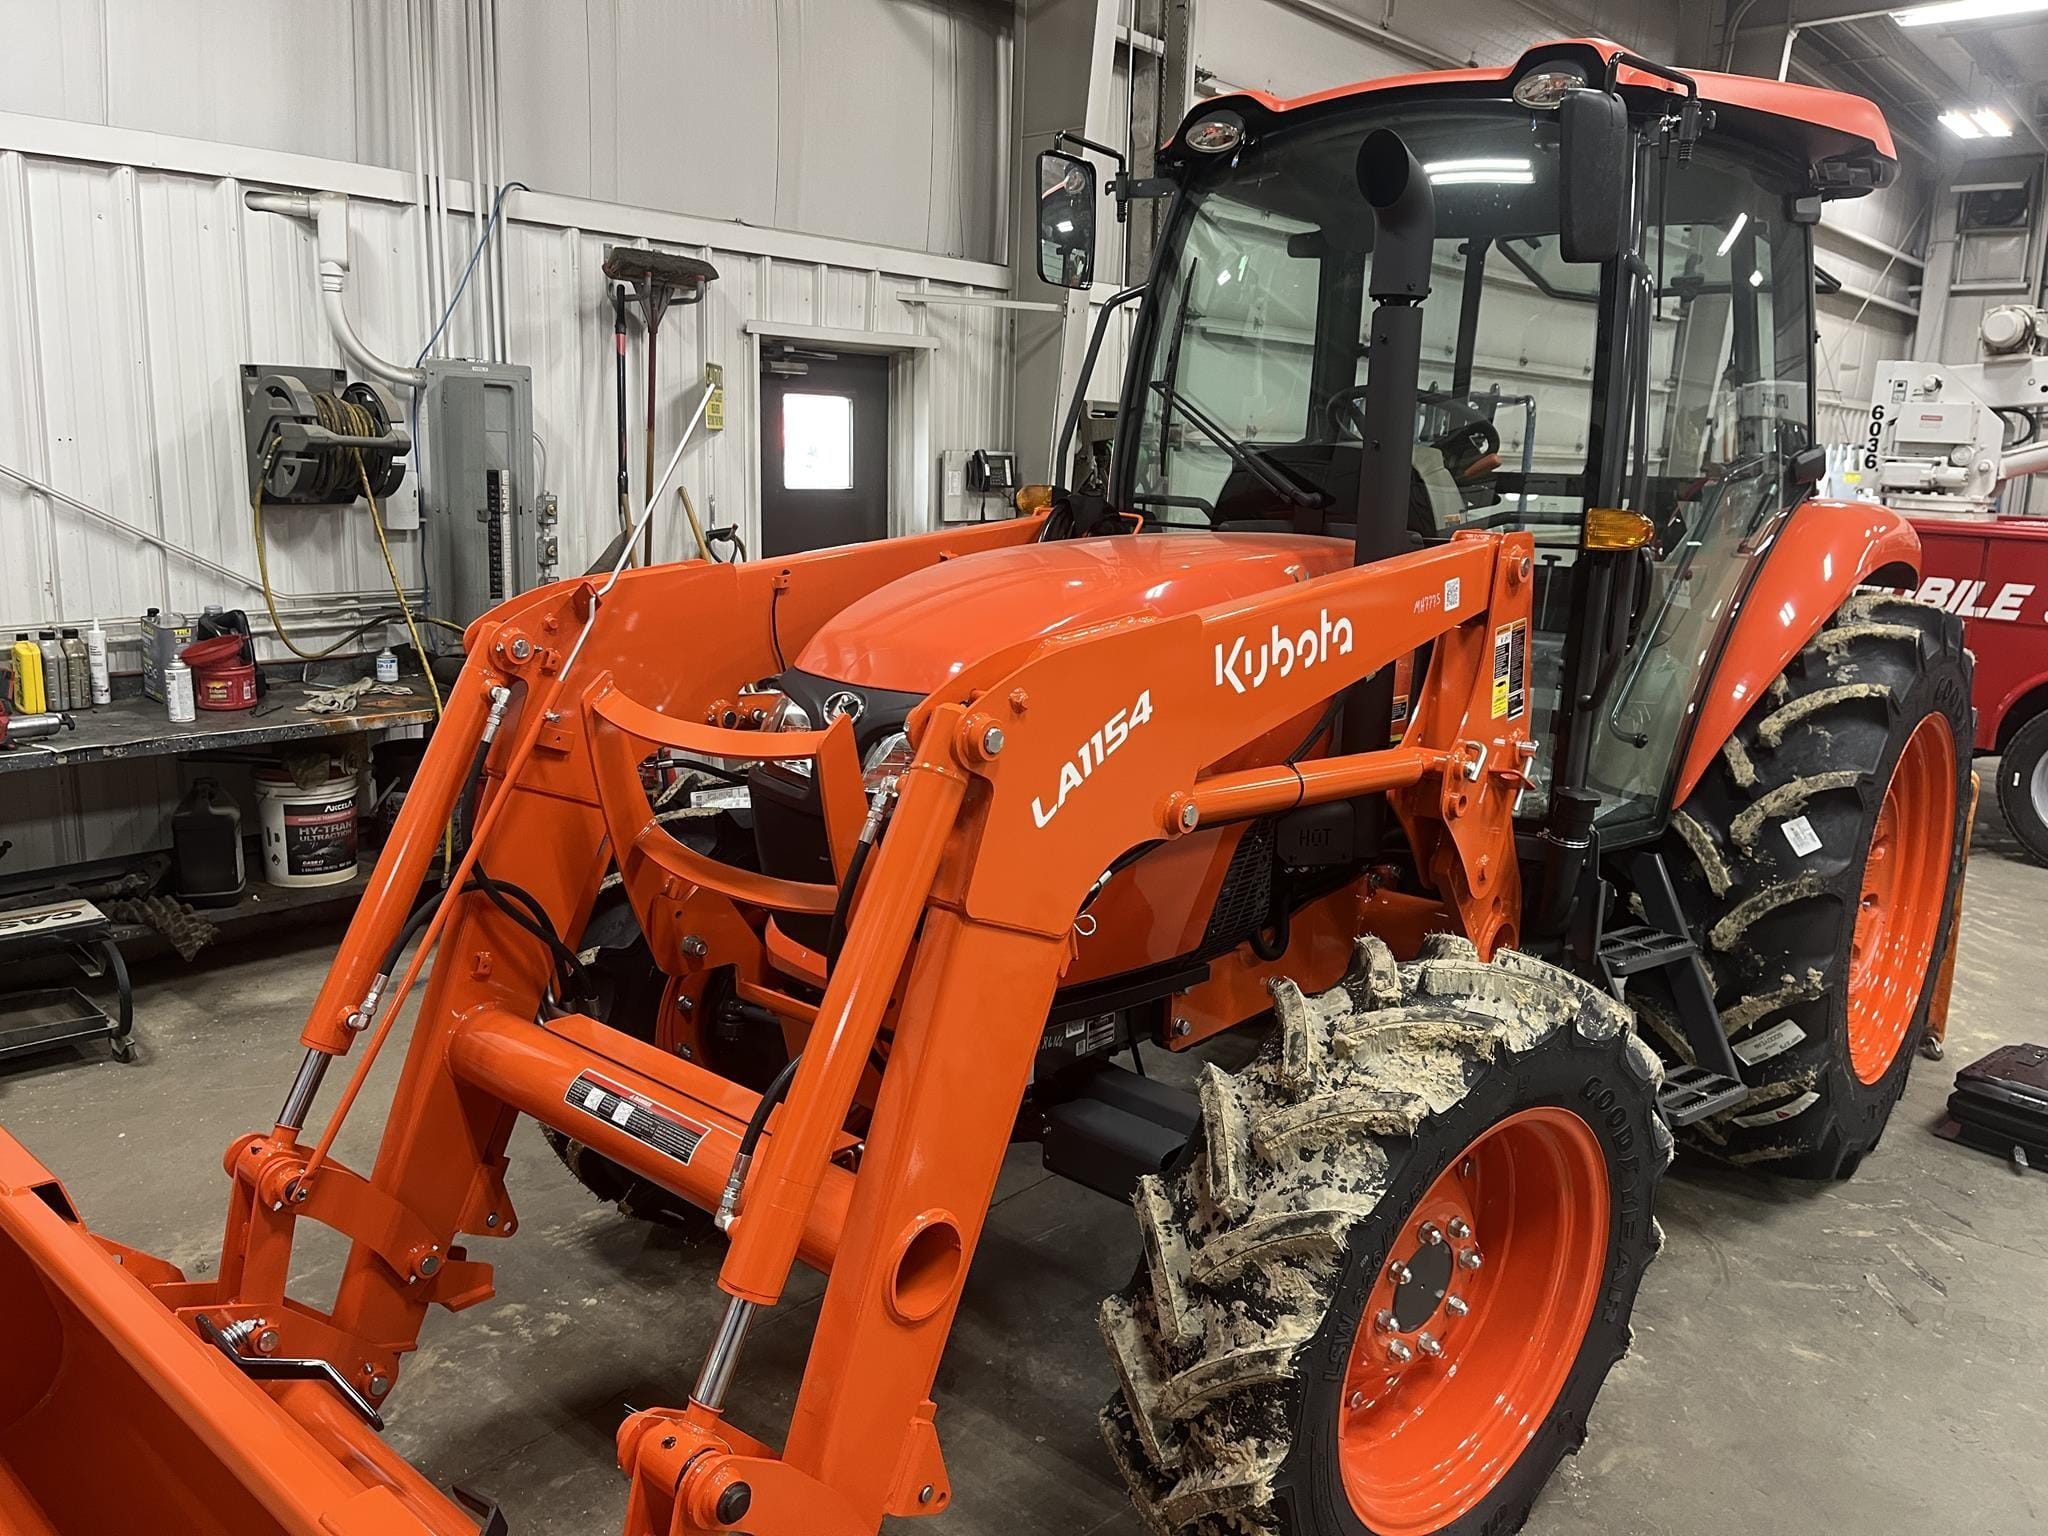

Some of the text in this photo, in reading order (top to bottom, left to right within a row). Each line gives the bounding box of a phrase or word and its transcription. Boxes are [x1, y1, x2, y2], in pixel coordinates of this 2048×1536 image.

[1864, 404, 1885, 470] 6036
[1852, 576, 2036, 621] BILE
[1215, 608, 1353, 694] Kubota
[1031, 688, 1153, 829] LA1154
[299, 821, 352, 836] HY-TRAN
[1299, 827, 1332, 848] HOT
[1582, 1074, 1641, 1324] GOODYEAR
[1322, 1311, 1357, 1382] LSW
